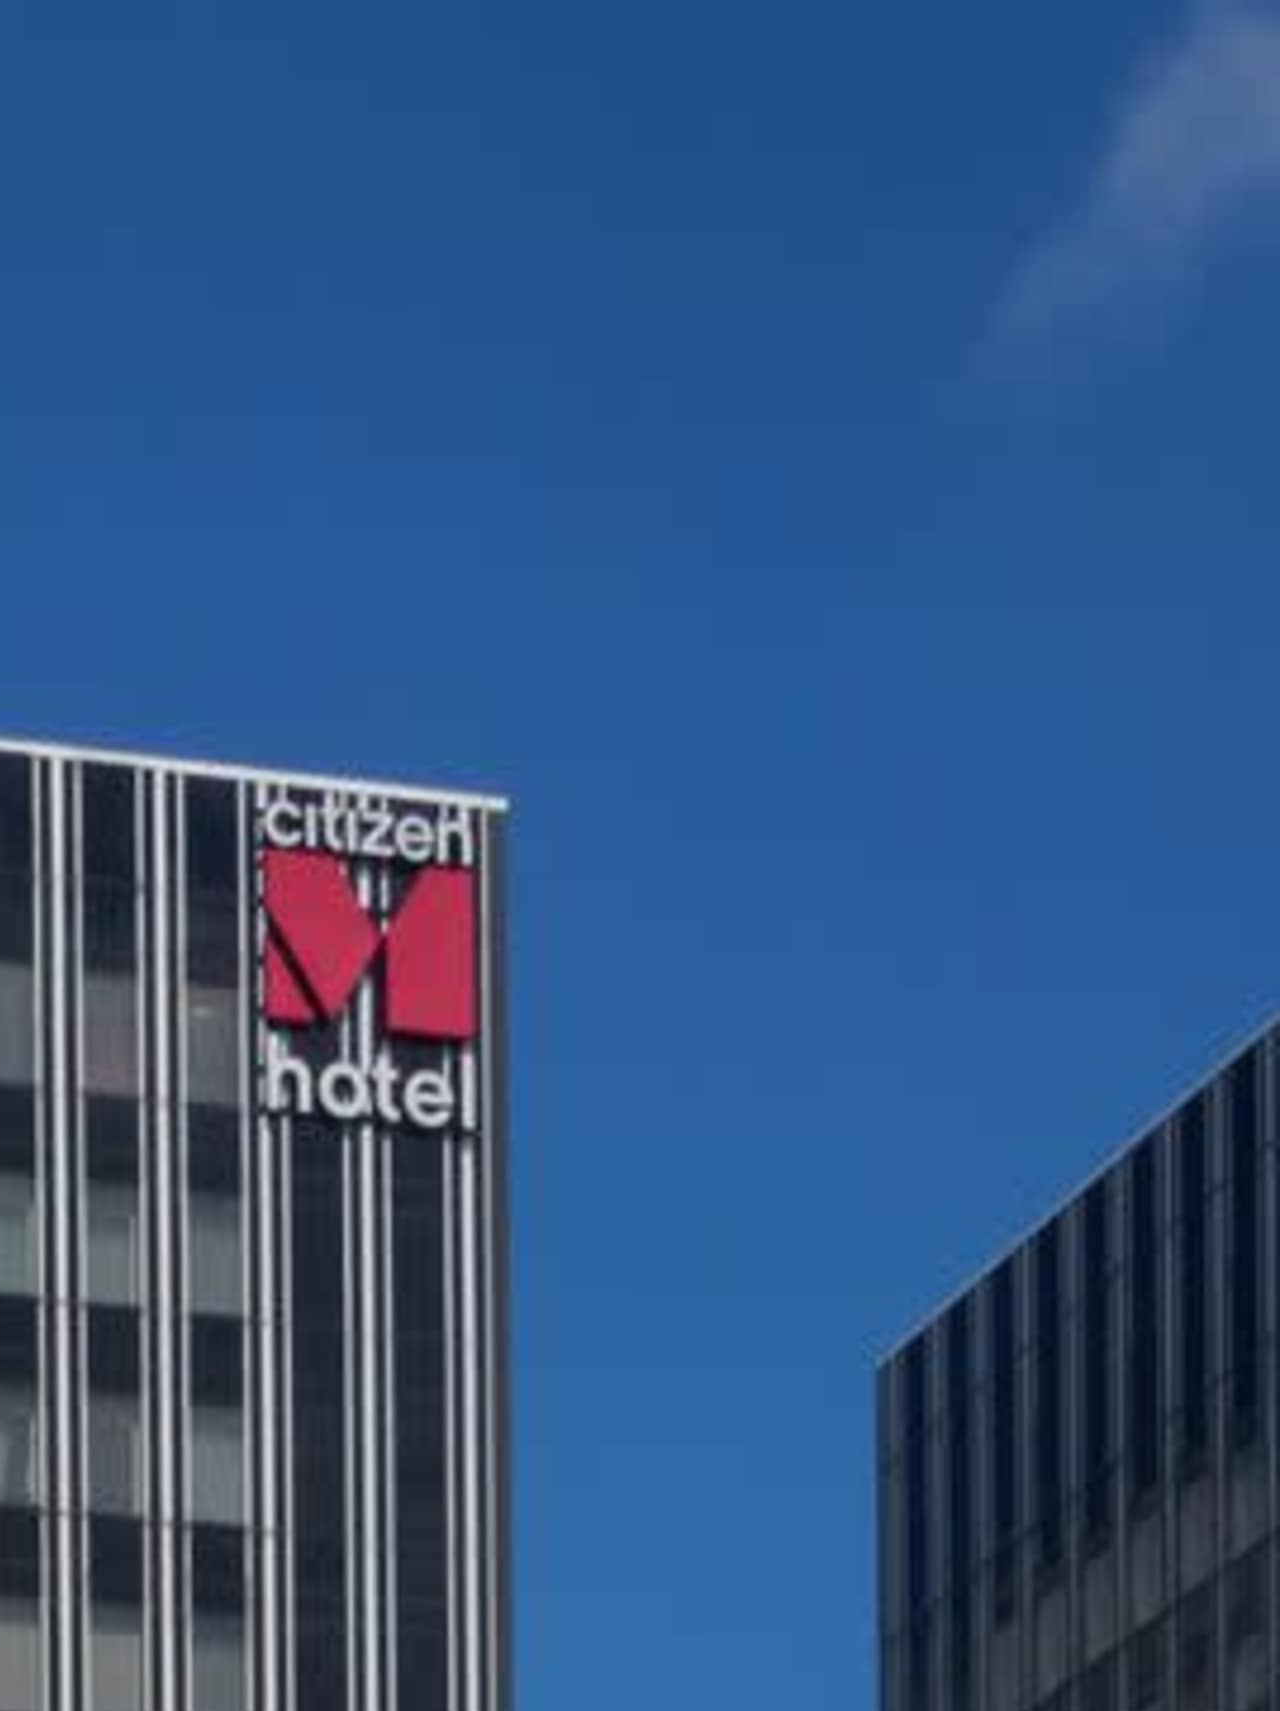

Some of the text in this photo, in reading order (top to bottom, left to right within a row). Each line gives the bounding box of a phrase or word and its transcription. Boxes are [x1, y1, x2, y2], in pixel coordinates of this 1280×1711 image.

[265, 797, 473, 866] citizen
[262, 850, 475, 1041] M
[266, 1032, 476, 1130] hotel
